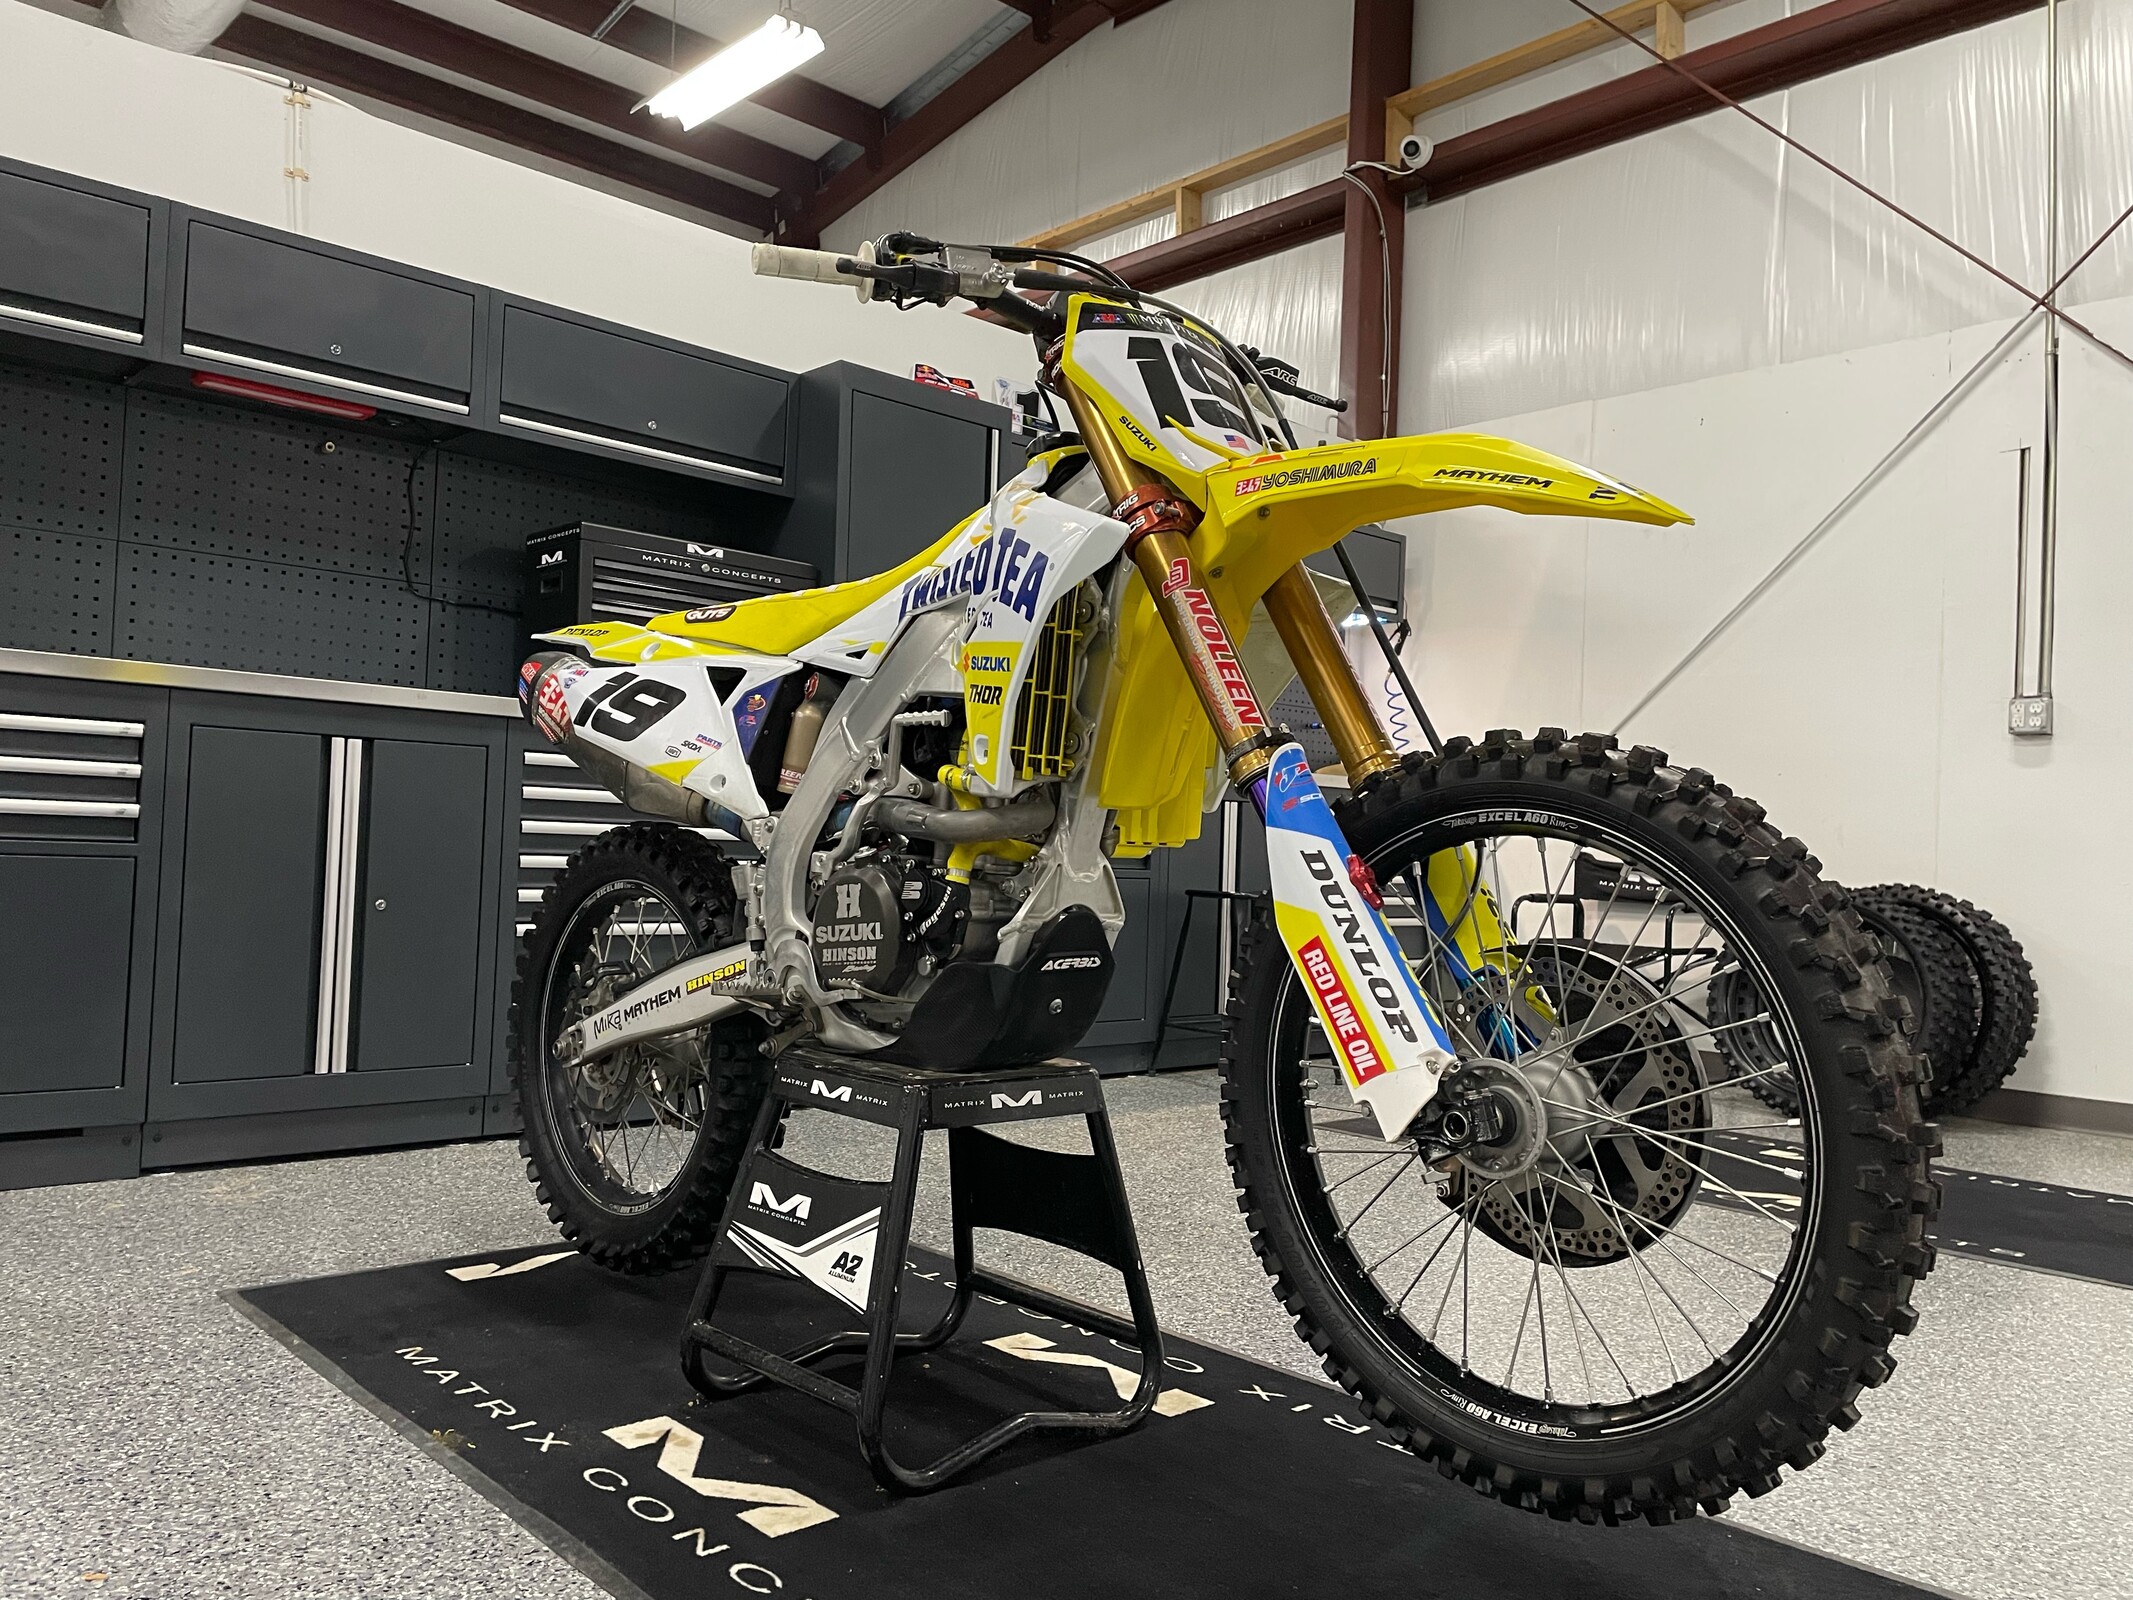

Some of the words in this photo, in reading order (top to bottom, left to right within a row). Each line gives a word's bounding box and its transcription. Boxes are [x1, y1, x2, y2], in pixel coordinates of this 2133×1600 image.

[1092, 313, 1126, 324] AMA
[1259, 366, 1298, 387] ARC
[1127, 336, 1264, 447] 19
[1118, 415, 1157, 452] SUZUKI
[1261, 463, 1377, 490] YOSHIMURA
[1433, 467, 1553, 488] MAYHEM
[526, 537, 546, 546] MATRIX
[548, 528, 580, 540] CONCEPTS
[642, 554, 692, 569] MATRIX
[711, 566, 782, 584] CONCEPTS
[991, 527, 1049, 623] TEA
[685, 605, 733, 621] GUTS
[1171, 591, 1203, 653] SUSPENSION
[562, 627, 610, 637] DUNLOP
[970, 655, 1011, 672] SUZUKI
[1183, 587, 1266, 728] NOLEEN
[969, 684, 1003, 705] THOR
[573, 671, 687, 742] 19
[1478, 812, 1522, 823] EXCEL
[1524, 812, 1549, 824] A60
[1599, 880, 1641, 890] MARIX
[919, 886, 953, 935] Boyesen
[815, 922, 883, 943] SUZUKI
[822, 945, 877, 961] HINSON
[1299, 849, 1419, 1044] DUNLOP
[1040, 956, 1101, 971] ACERBIS
[686, 959, 747, 993] HINSON
[624, 986, 682, 1022] MAYHEM
[1304, 947, 1337, 989] RED
[1324, 990, 1361, 1040] LINE
[1347, 1036, 1377, 1078] OIL
[781, 1076, 809, 1088] MATRIX
[855, 1094, 888, 1106] MATRIX
[944, 1099, 986, 1109] MATRIX
[1048, 1090, 1085, 1099] MATRIX
[747, 1204, 770, 1215] MATRIX
[771, 1211, 807, 1226] CONCEPTS
[830, 1250, 864, 1277] A2
[828, 1269, 856, 1283] ALUMINUM
[1237, 1383, 1417, 1457] TRIX
[1466, 1402, 1492, 1420] A60
[1492, 1412, 1538, 1434] EXCEL
[394, 1345, 571, 1454] MATRIX
[582, 1466, 790, 1597] CONC
